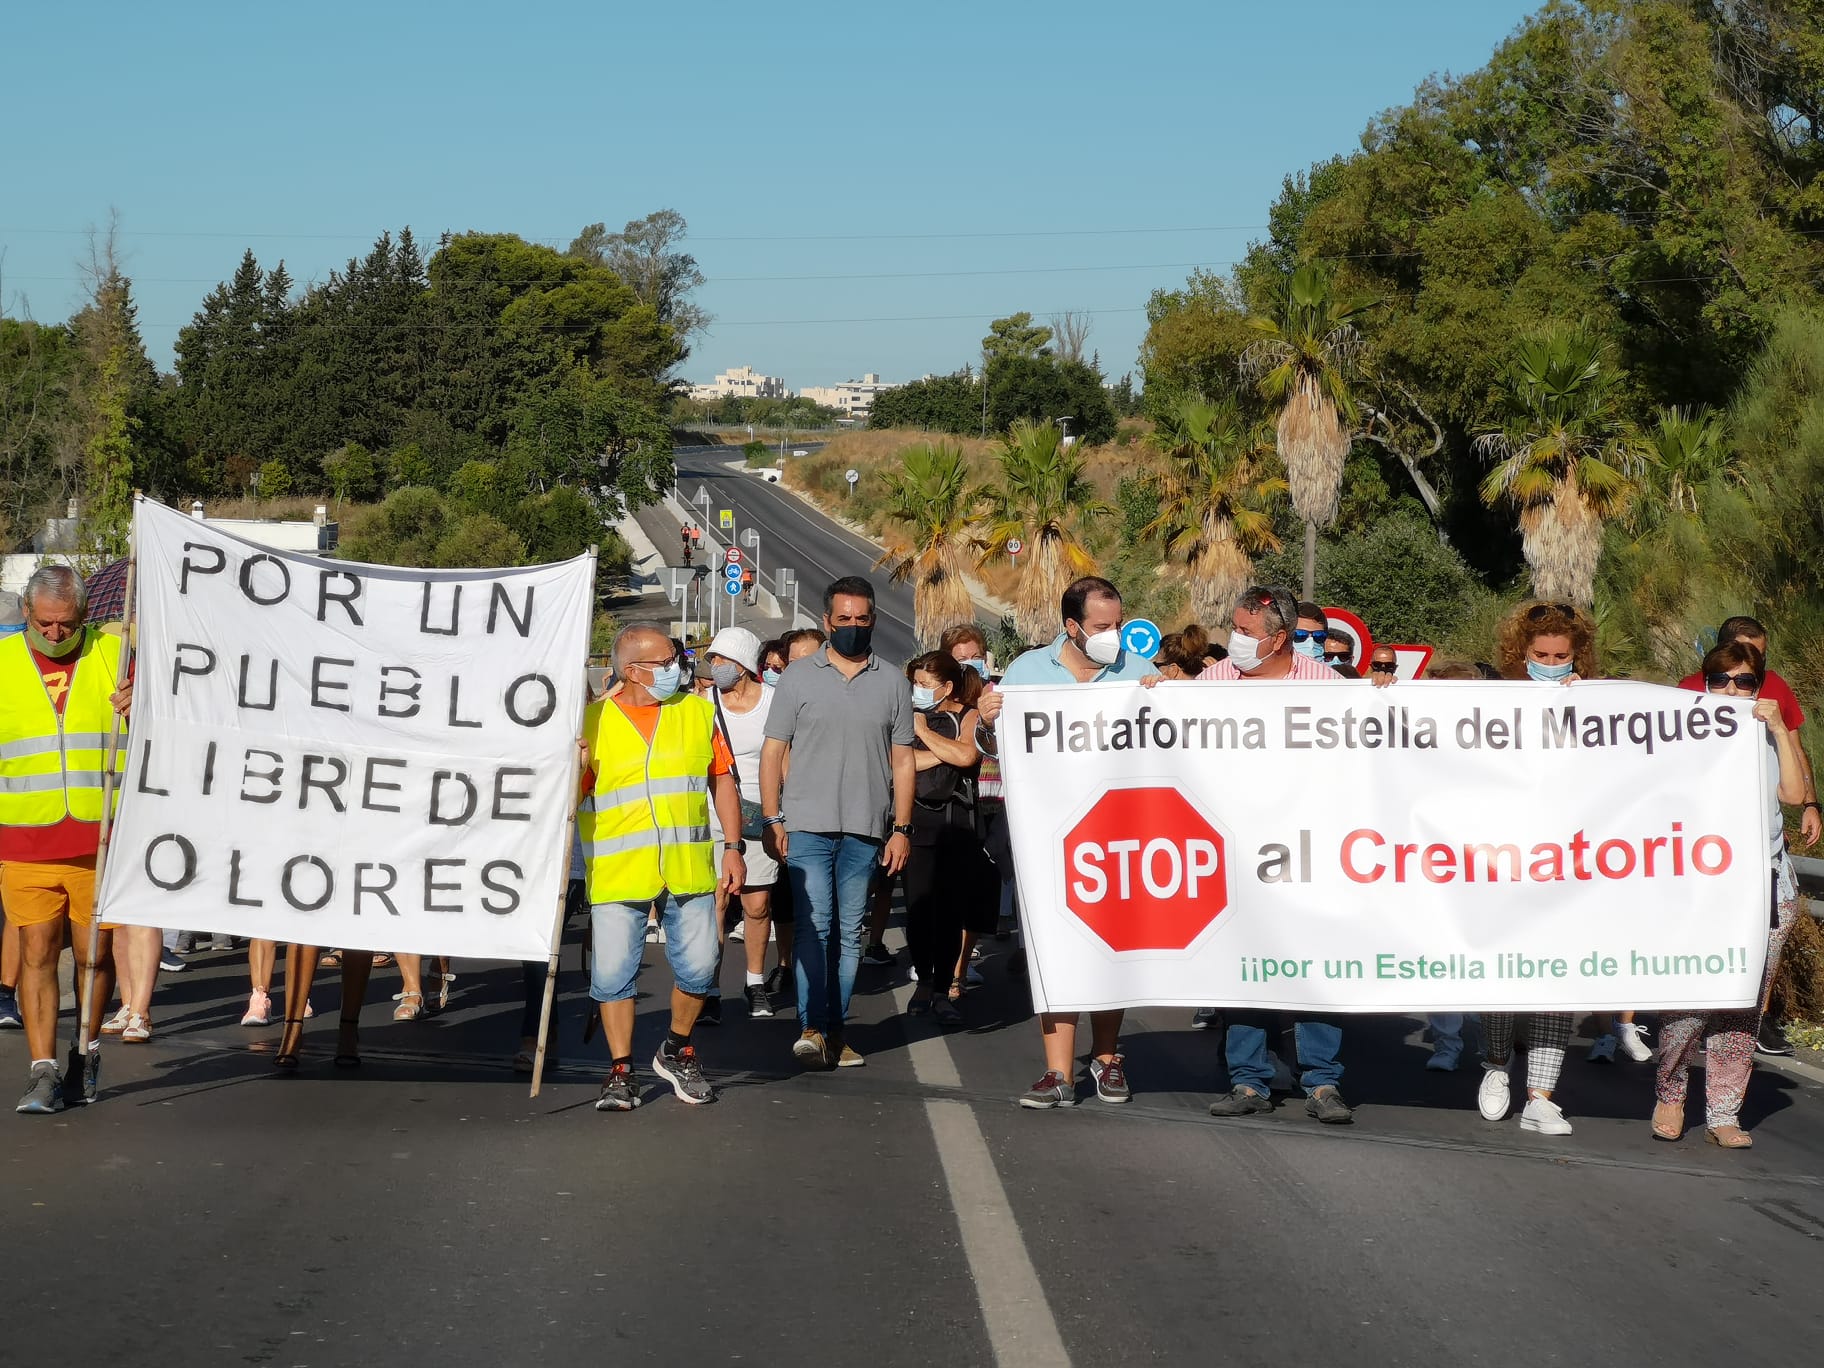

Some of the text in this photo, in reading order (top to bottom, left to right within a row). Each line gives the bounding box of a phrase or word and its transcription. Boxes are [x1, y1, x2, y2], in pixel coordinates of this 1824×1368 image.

[180, 541, 535, 638] POR UN
[172, 643, 557, 728] PUEBLO
[1024, 690, 1739, 755] Plataforma Estella del Marqués
[138, 739, 537, 827] LIBRE DE
[145, 833, 523, 916] OLORES
[1073, 838, 1218, 904] STOP
[1256, 821, 1733, 884] al Crematorio
[1239, 947, 1749, 983] ¡¡por un Estella libre de humo!!
